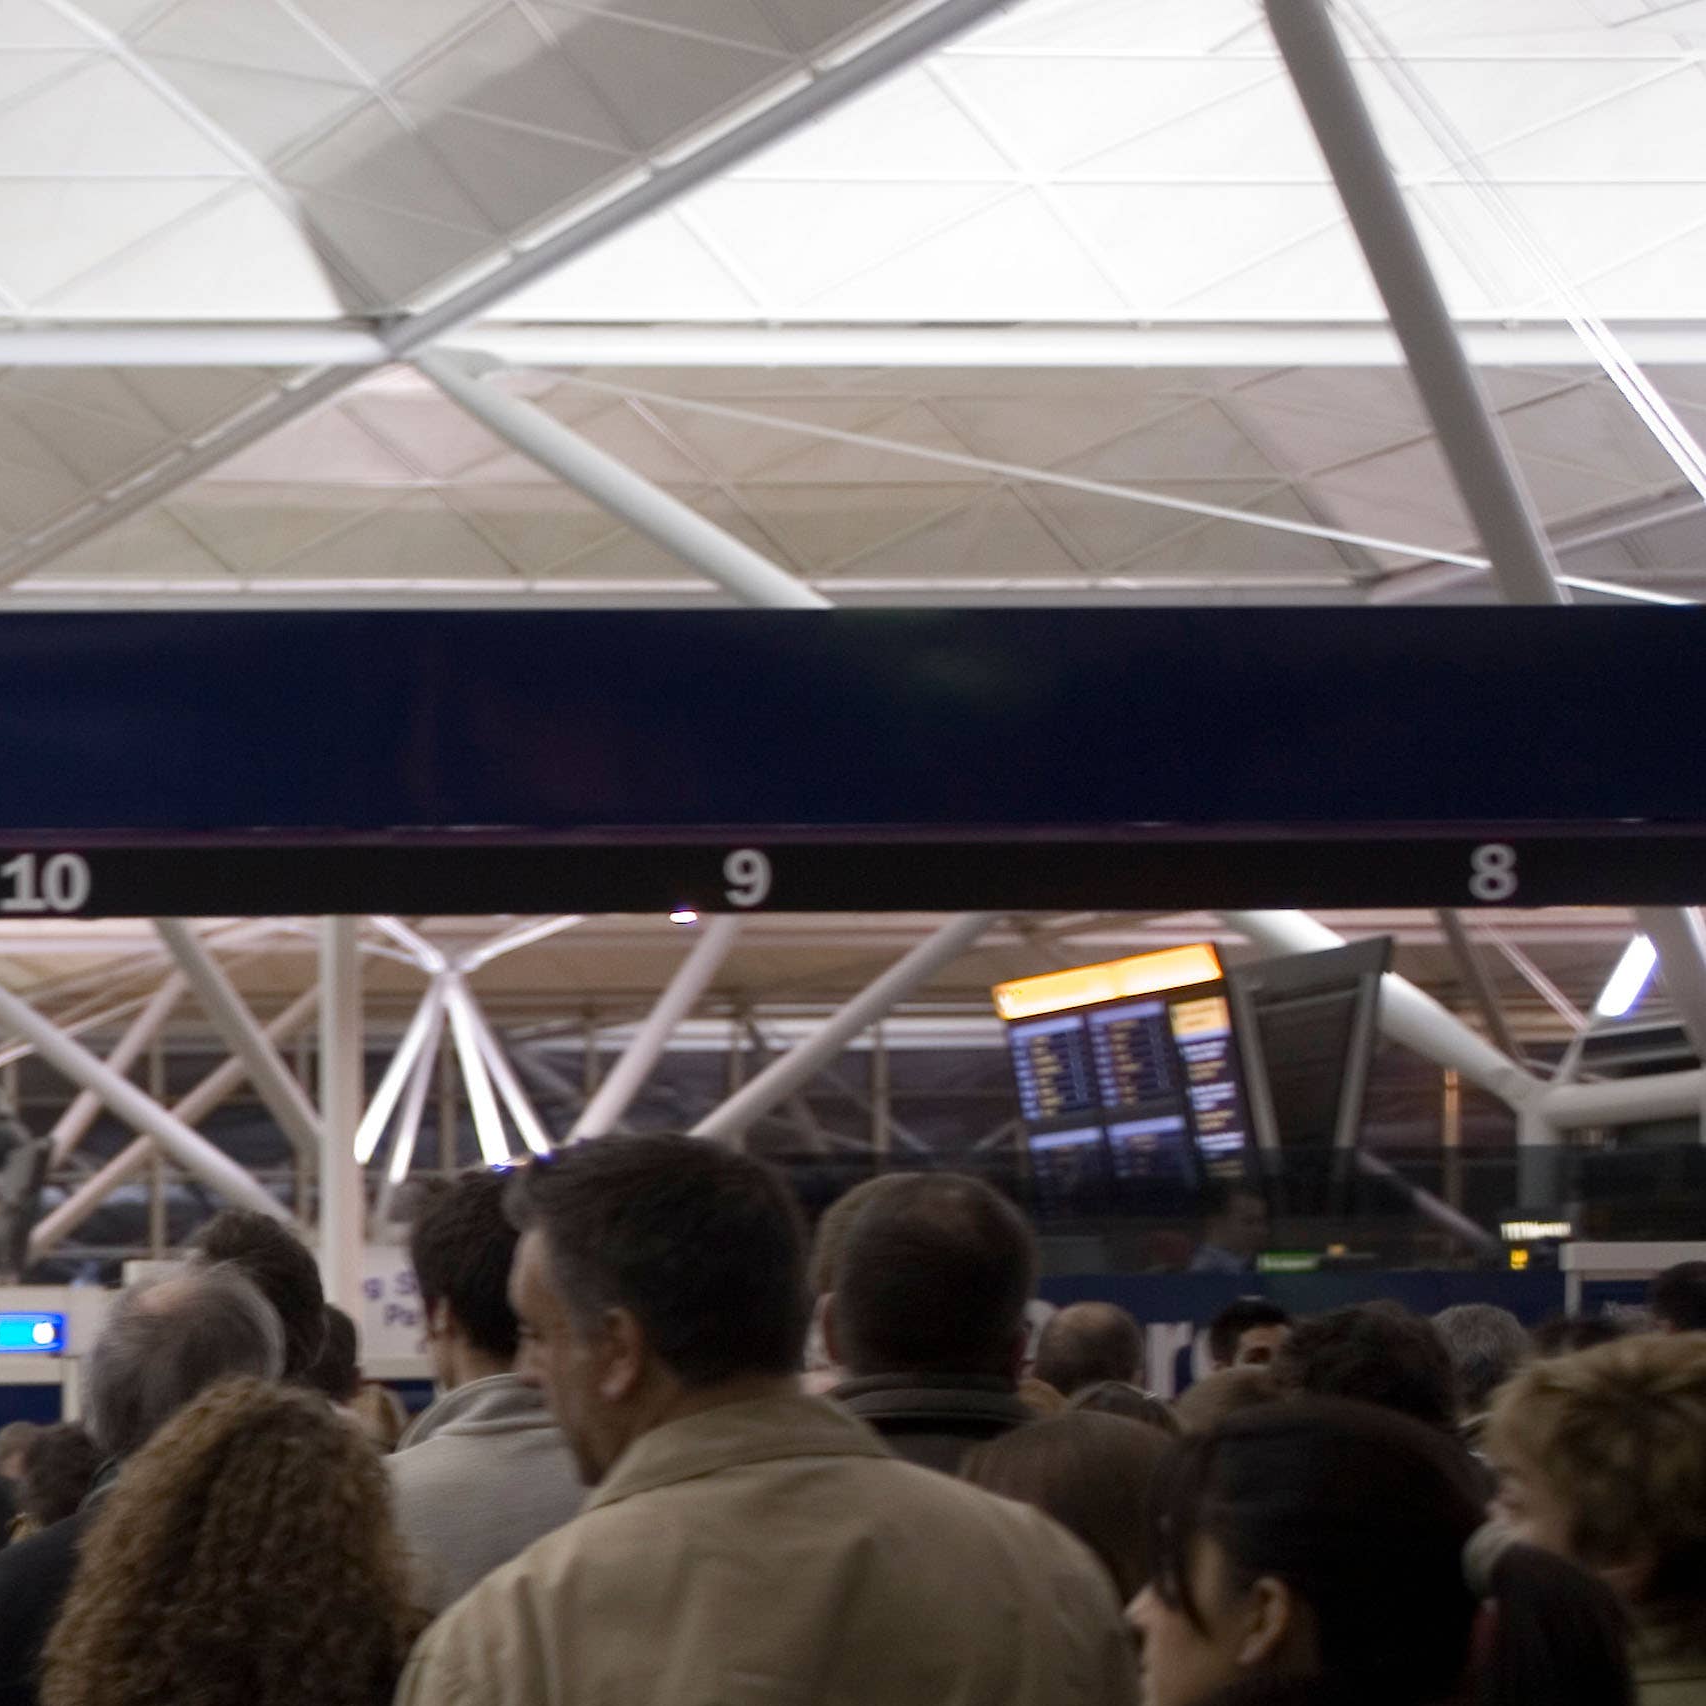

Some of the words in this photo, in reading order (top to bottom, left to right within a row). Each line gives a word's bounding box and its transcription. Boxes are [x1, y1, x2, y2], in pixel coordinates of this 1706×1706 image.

[0, 853, 90, 912] 10
[725, 849, 770, 906] 9
[1472, 845, 1515, 900] 8
